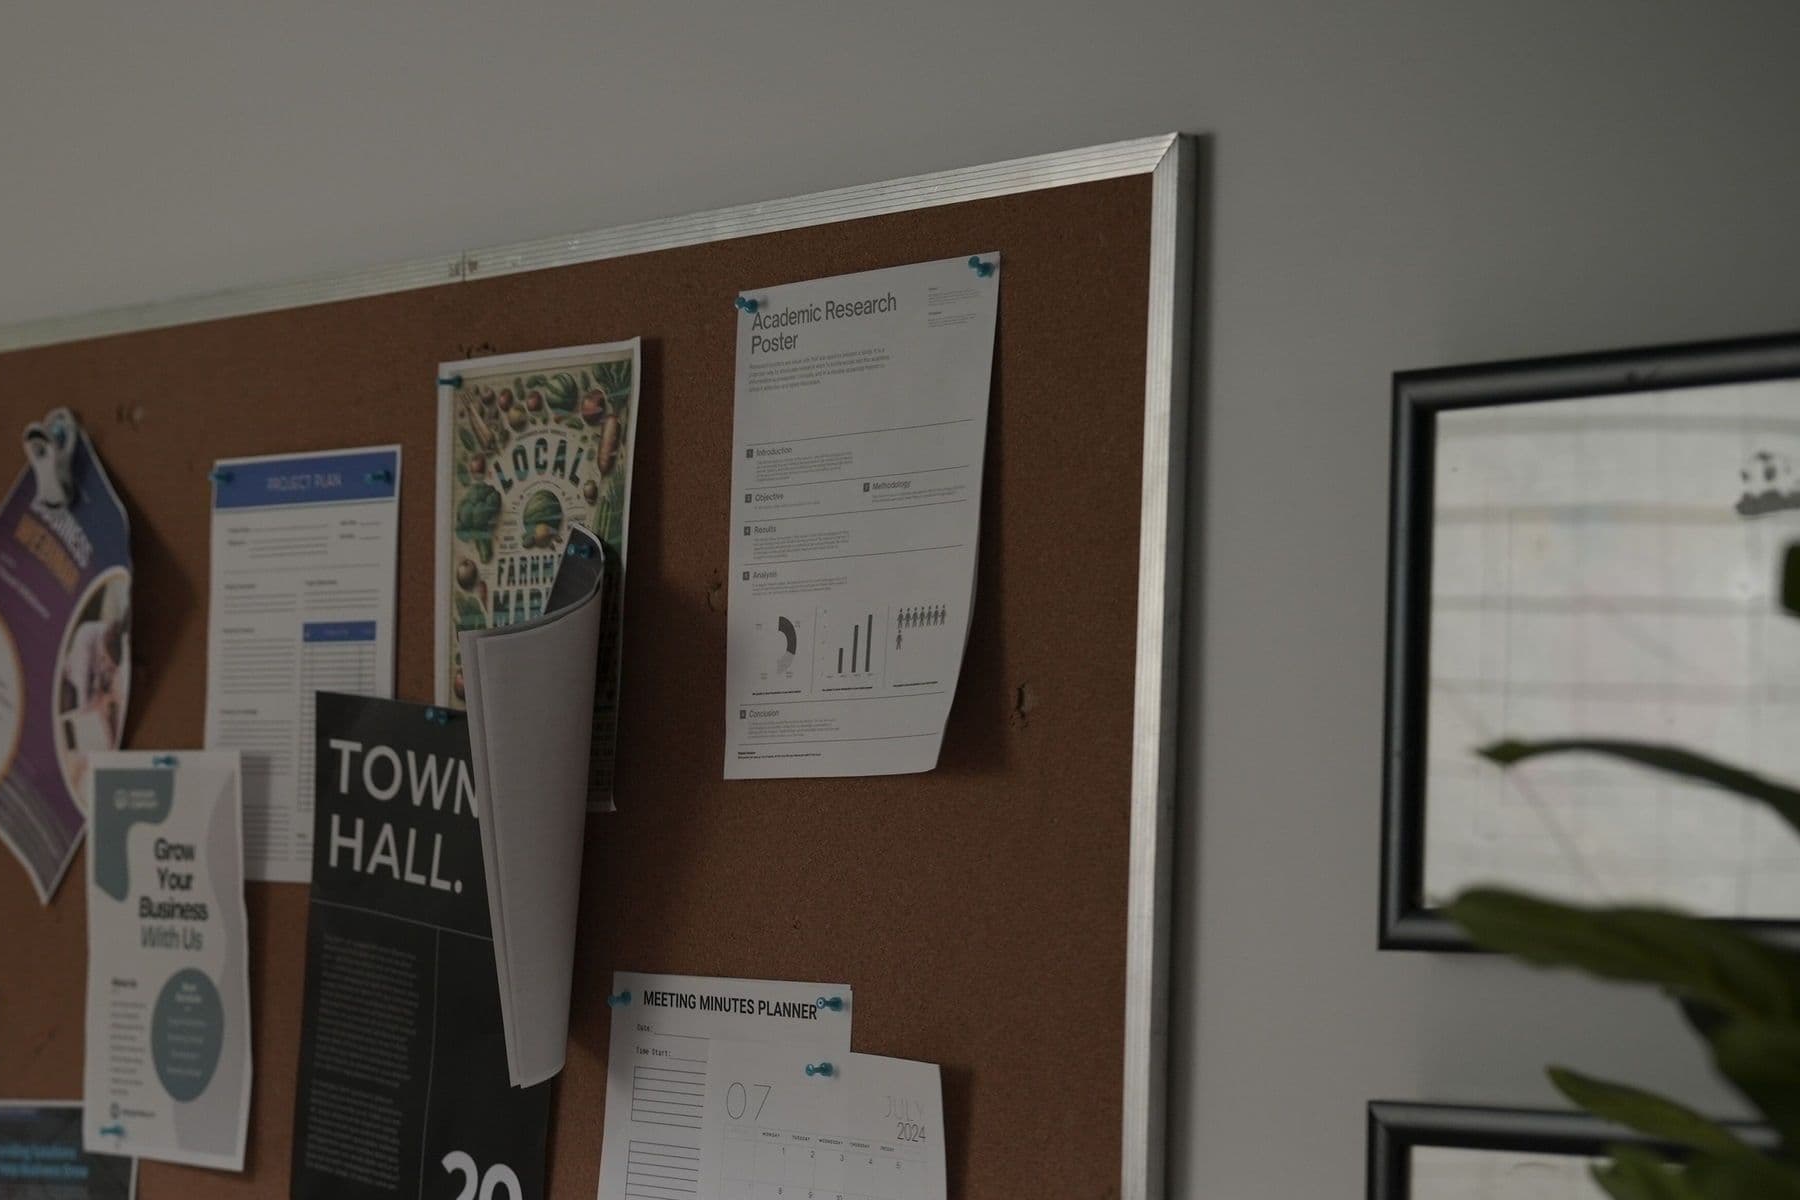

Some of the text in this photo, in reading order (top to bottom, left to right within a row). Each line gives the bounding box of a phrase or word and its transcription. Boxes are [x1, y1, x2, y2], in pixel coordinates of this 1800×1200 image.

[752, 304, 821, 331] Academic
[826, 292, 897, 320] Research
[752, 332, 798, 354] Poster
[493, 438, 584, 494] LOCAL
[330, 738, 480, 819] TOWN
[154, 837, 196, 861] Grow
[329, 814, 463, 893] HALL.
[157, 867, 193, 891] Your
[139, 895, 209, 922] Business
[141, 925, 203, 951] With Us
[643, 990, 817, 1020] MEETING MINUTES PLANNER
[637, 1023, 653, 1033] Date:
[726, 1081, 772, 1121] 07
[897, 1121, 927, 1143] 2024
